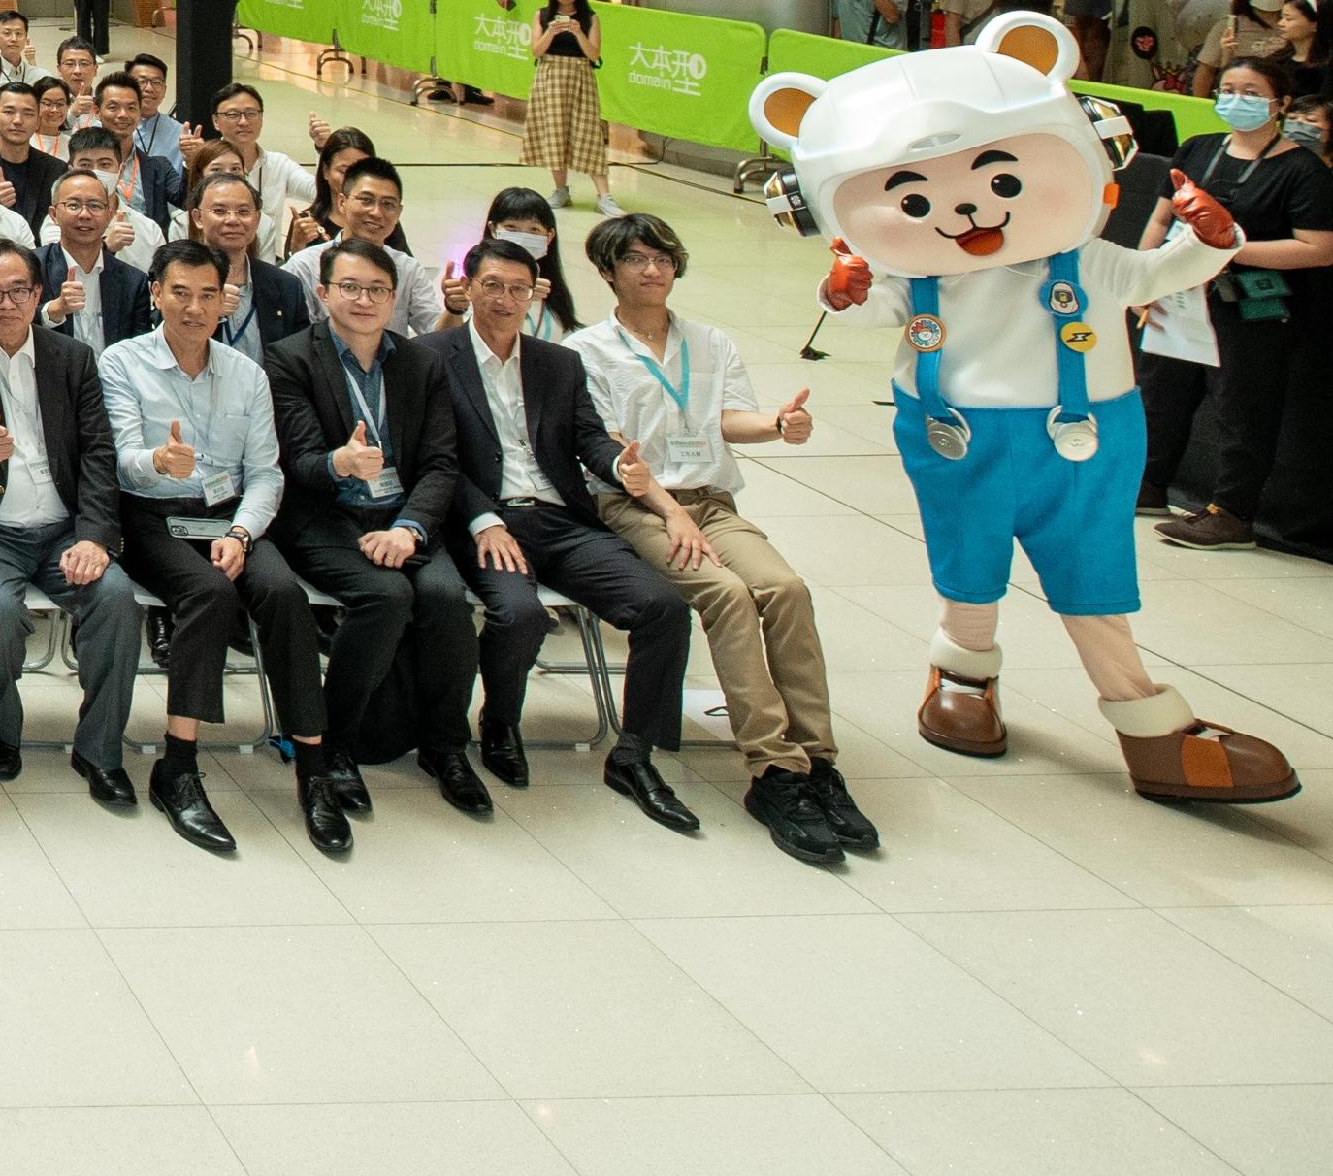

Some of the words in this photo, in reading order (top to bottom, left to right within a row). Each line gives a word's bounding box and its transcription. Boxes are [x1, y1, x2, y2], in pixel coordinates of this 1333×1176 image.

[474, 14, 532, 61] 大本型
[629, 43, 707, 97] 大本型
[629, 65, 673, 91] domain
